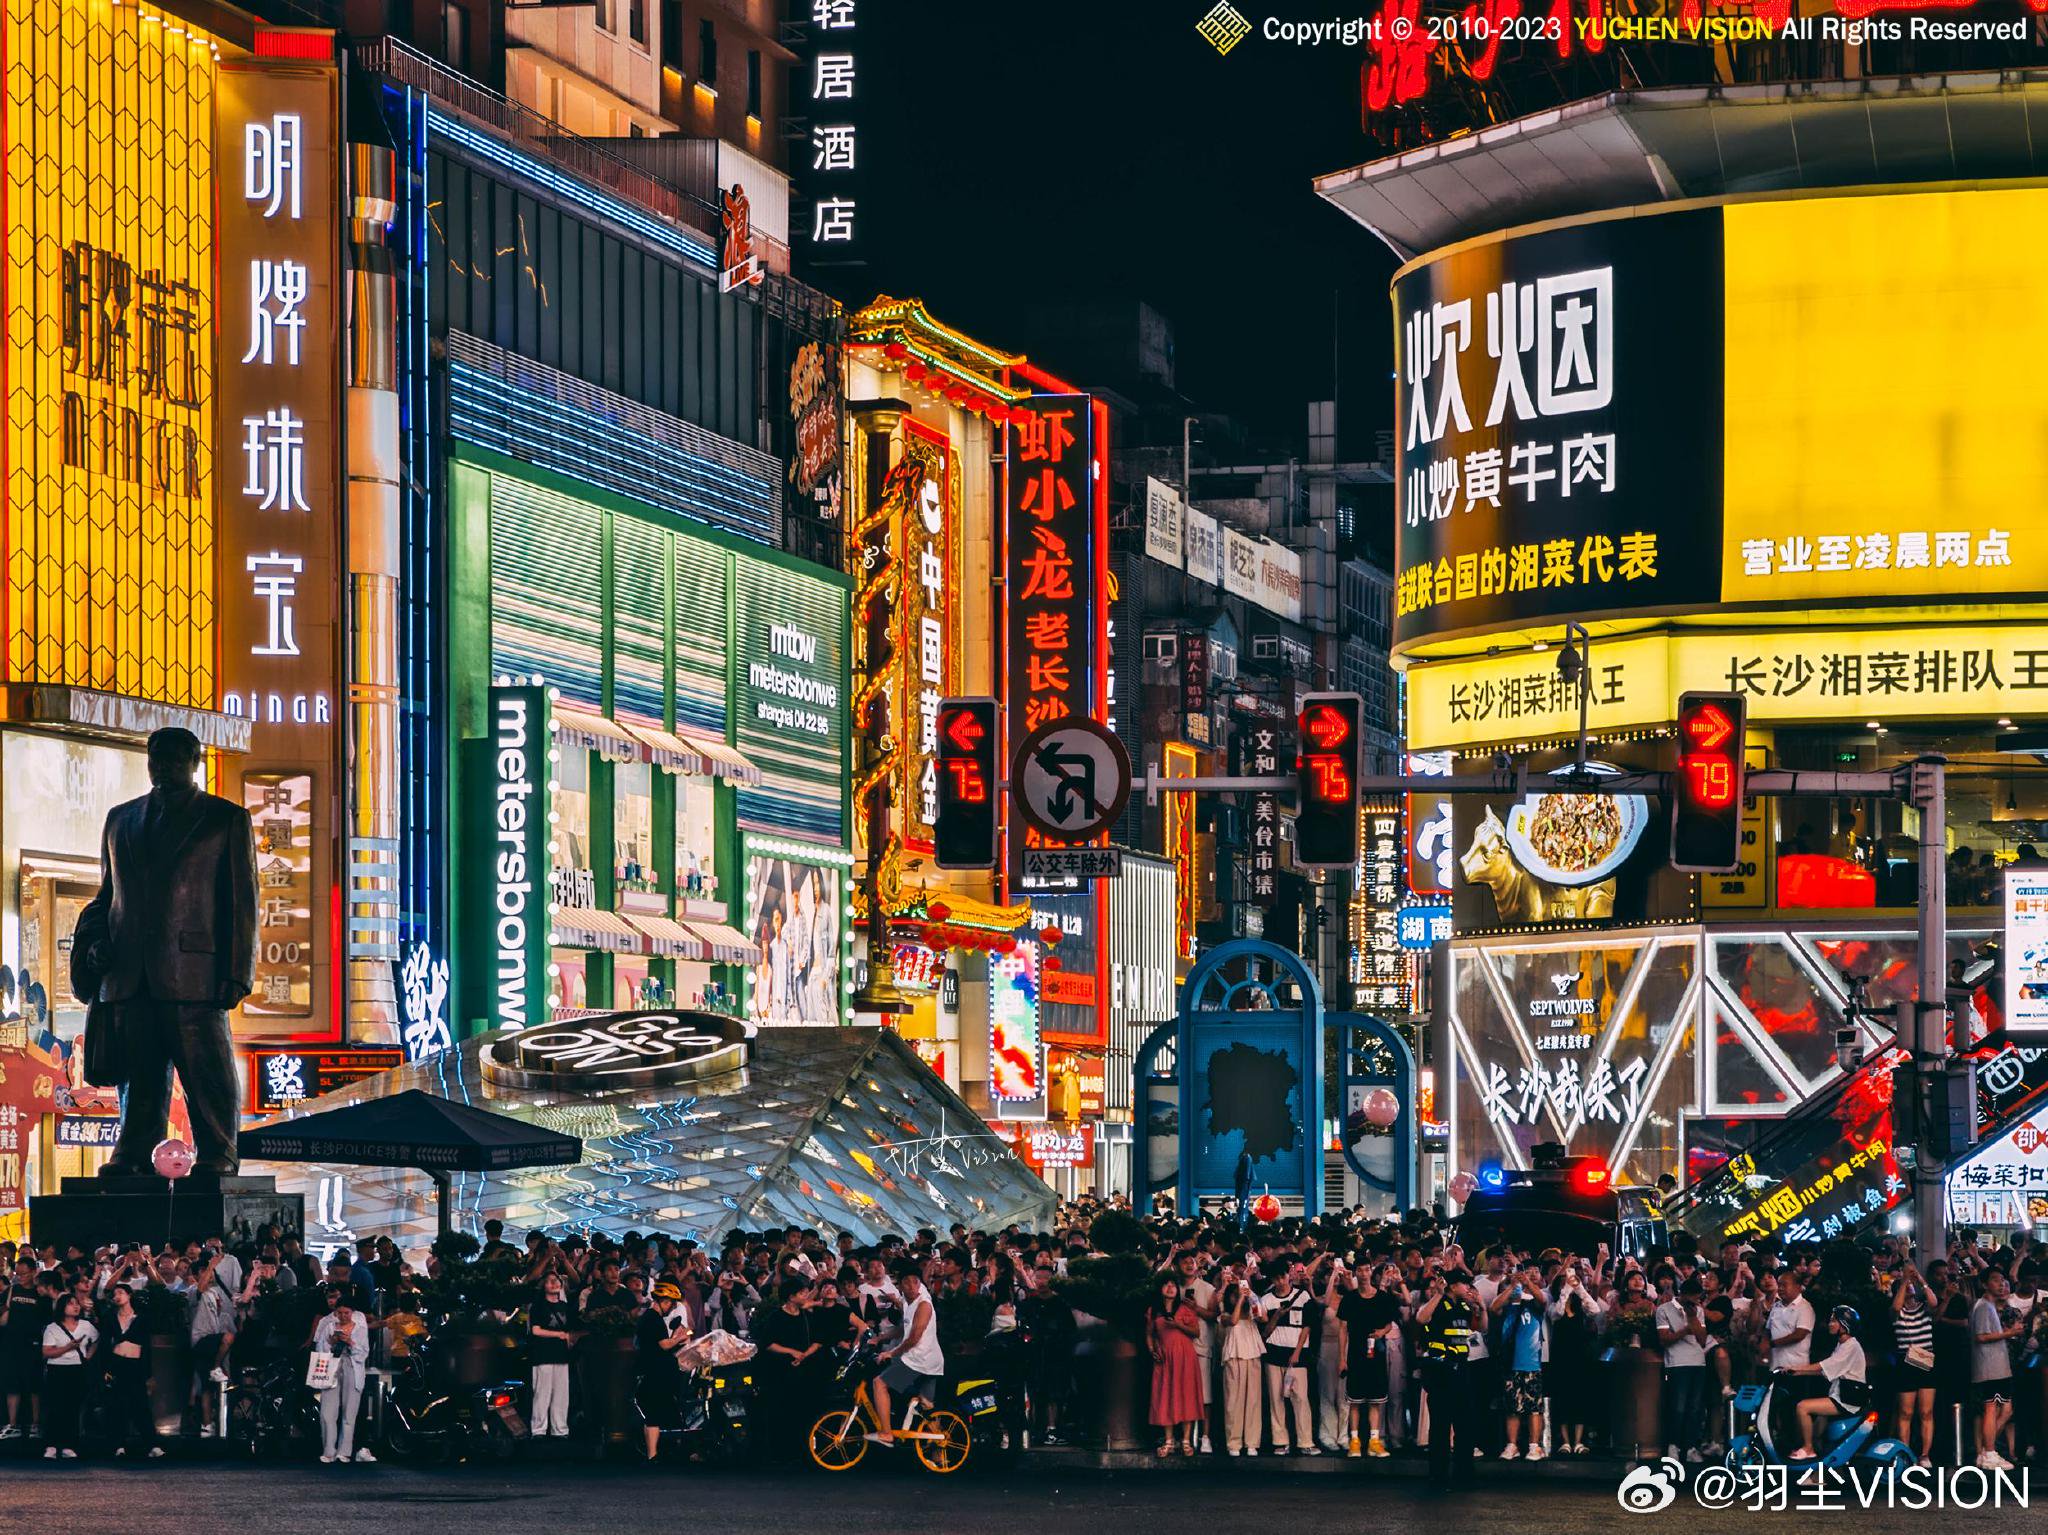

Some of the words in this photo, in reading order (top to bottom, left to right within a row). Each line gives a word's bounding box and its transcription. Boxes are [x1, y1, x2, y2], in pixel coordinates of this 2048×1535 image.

[1406, 266, 1614, 451] 炊烟
[242, 113, 311, 657] 明牌珠宝
[1406, 432, 1616, 528] 小炒黄牛肉
[1741, 528, 2013, 576] 营业至凌晨两点
[770, 622, 817, 664] mtbw
[749, 662, 838, 709] metersbonwe
[1724, 648, 2048, 698] 长沙湘菜排队王
[1311, 760, 1348, 799] 75
[1692, 762, 1729, 800] 79
[1254, 728, 1276, 896] 文和美食市集
[1029, 852, 1116, 875] 公交车除外
[1402, 915, 1452, 941] 湖南
[1529, 999, 1596, 1016] SEPTWOLVES
[1482, 1056, 1649, 1126] 长沙我来了
[1960, 1163, 2048, 1189] 梅菜扣
